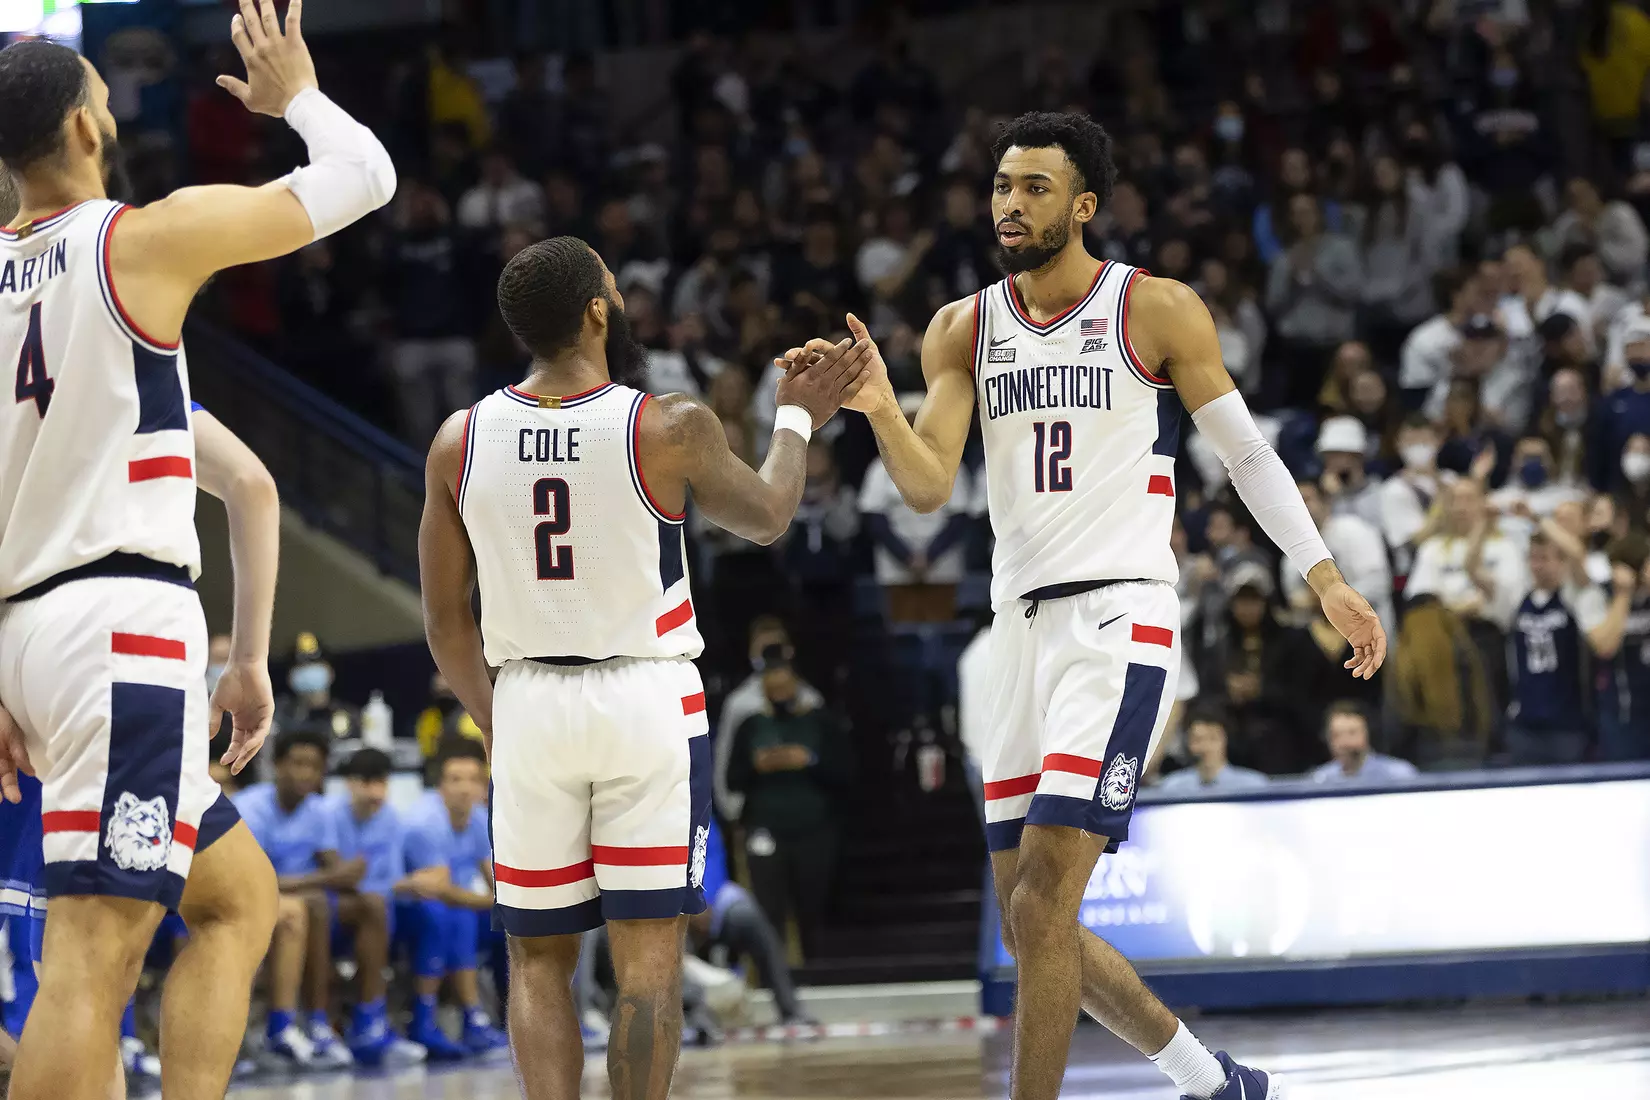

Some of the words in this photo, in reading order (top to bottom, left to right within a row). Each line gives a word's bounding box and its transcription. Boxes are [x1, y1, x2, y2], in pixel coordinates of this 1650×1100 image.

[0, 238, 67, 294] ARTIN
[15, 301, 55, 420] 4
[1081, 343, 1109, 352] EAST
[1084, 337, 1104, 346] BIG
[985, 365, 1114, 421] CONNECTICUT
[518, 427, 581, 463] COLE
[1033, 421, 1073, 492] 12
[532, 477, 575, 581] 2
